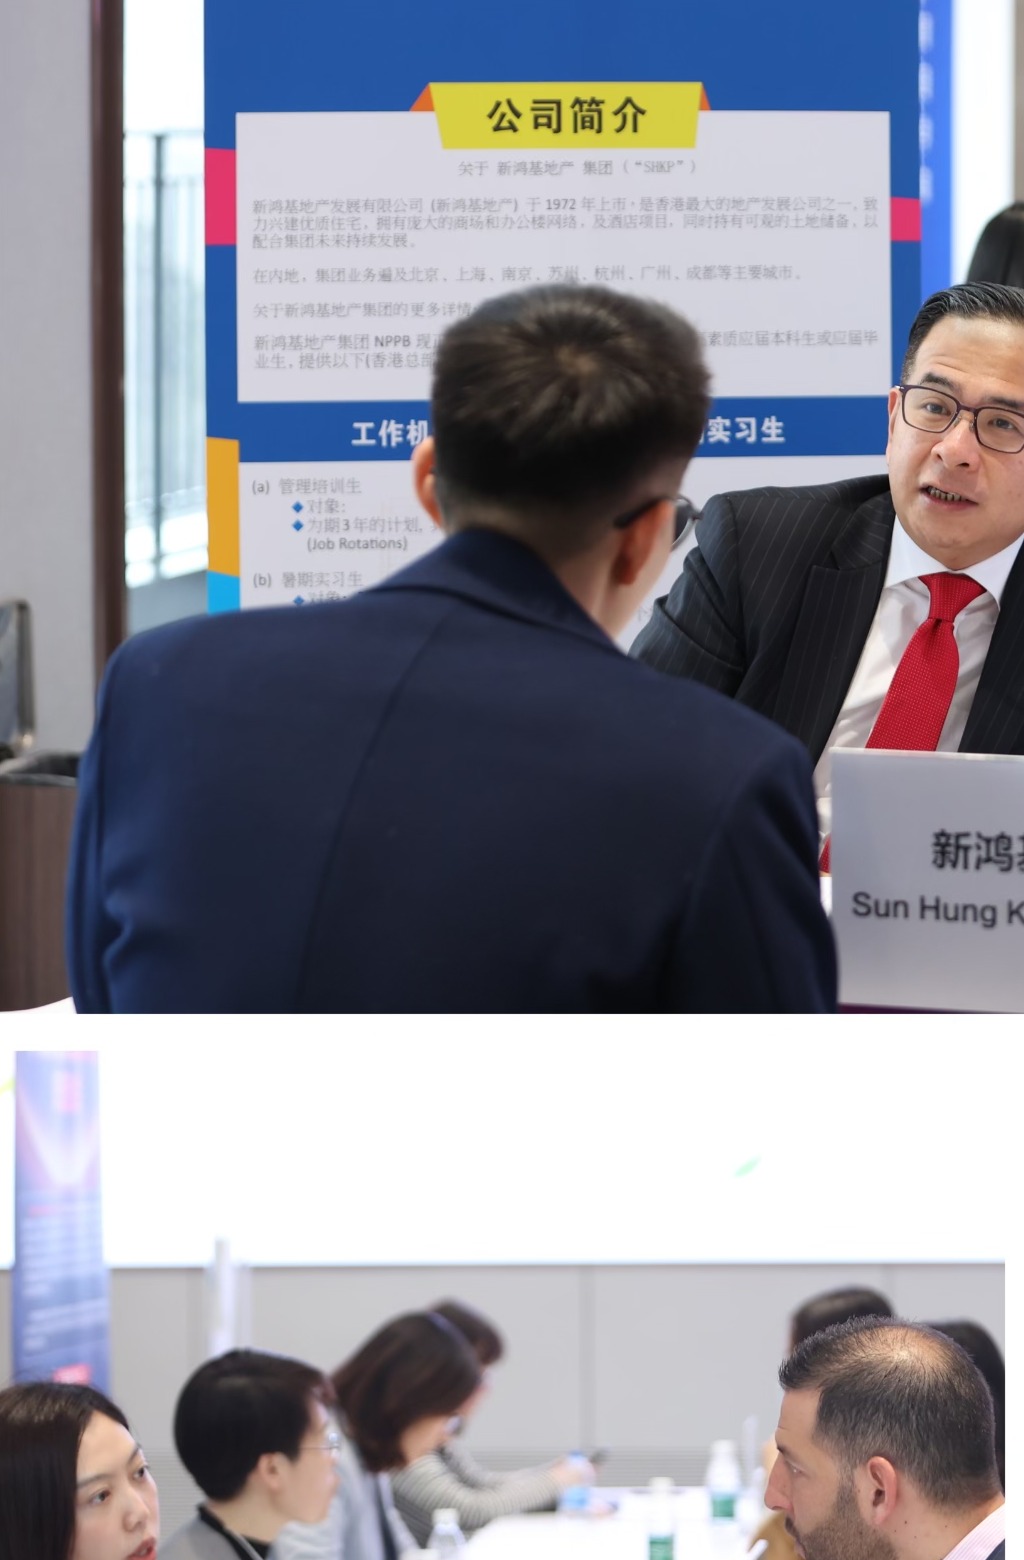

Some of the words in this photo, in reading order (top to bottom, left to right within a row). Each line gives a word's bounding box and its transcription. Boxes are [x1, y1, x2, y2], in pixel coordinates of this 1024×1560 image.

[486, 96, 647, 134] 公司简介
[458, 161, 489, 176] 关于
[497, 161, 574, 176] 新鸿基地产
[583, 160, 613, 175] 集团
[546, 199, 576, 210] 1972
[374, 336, 411, 348] NPPB
[700, 415, 785, 443] 实习生
[252, 480, 270, 495] (a)
[279, 478, 362, 494] 管理培训生
[307, 537, 335, 552] (Job
[339, 536, 408, 550] Rotations)
[253, 573, 272, 587] (b)
[282, 571, 363, 588] 暑期实习生
[852, 891, 909, 919] Sun
[919, 896, 998, 929] Hung
